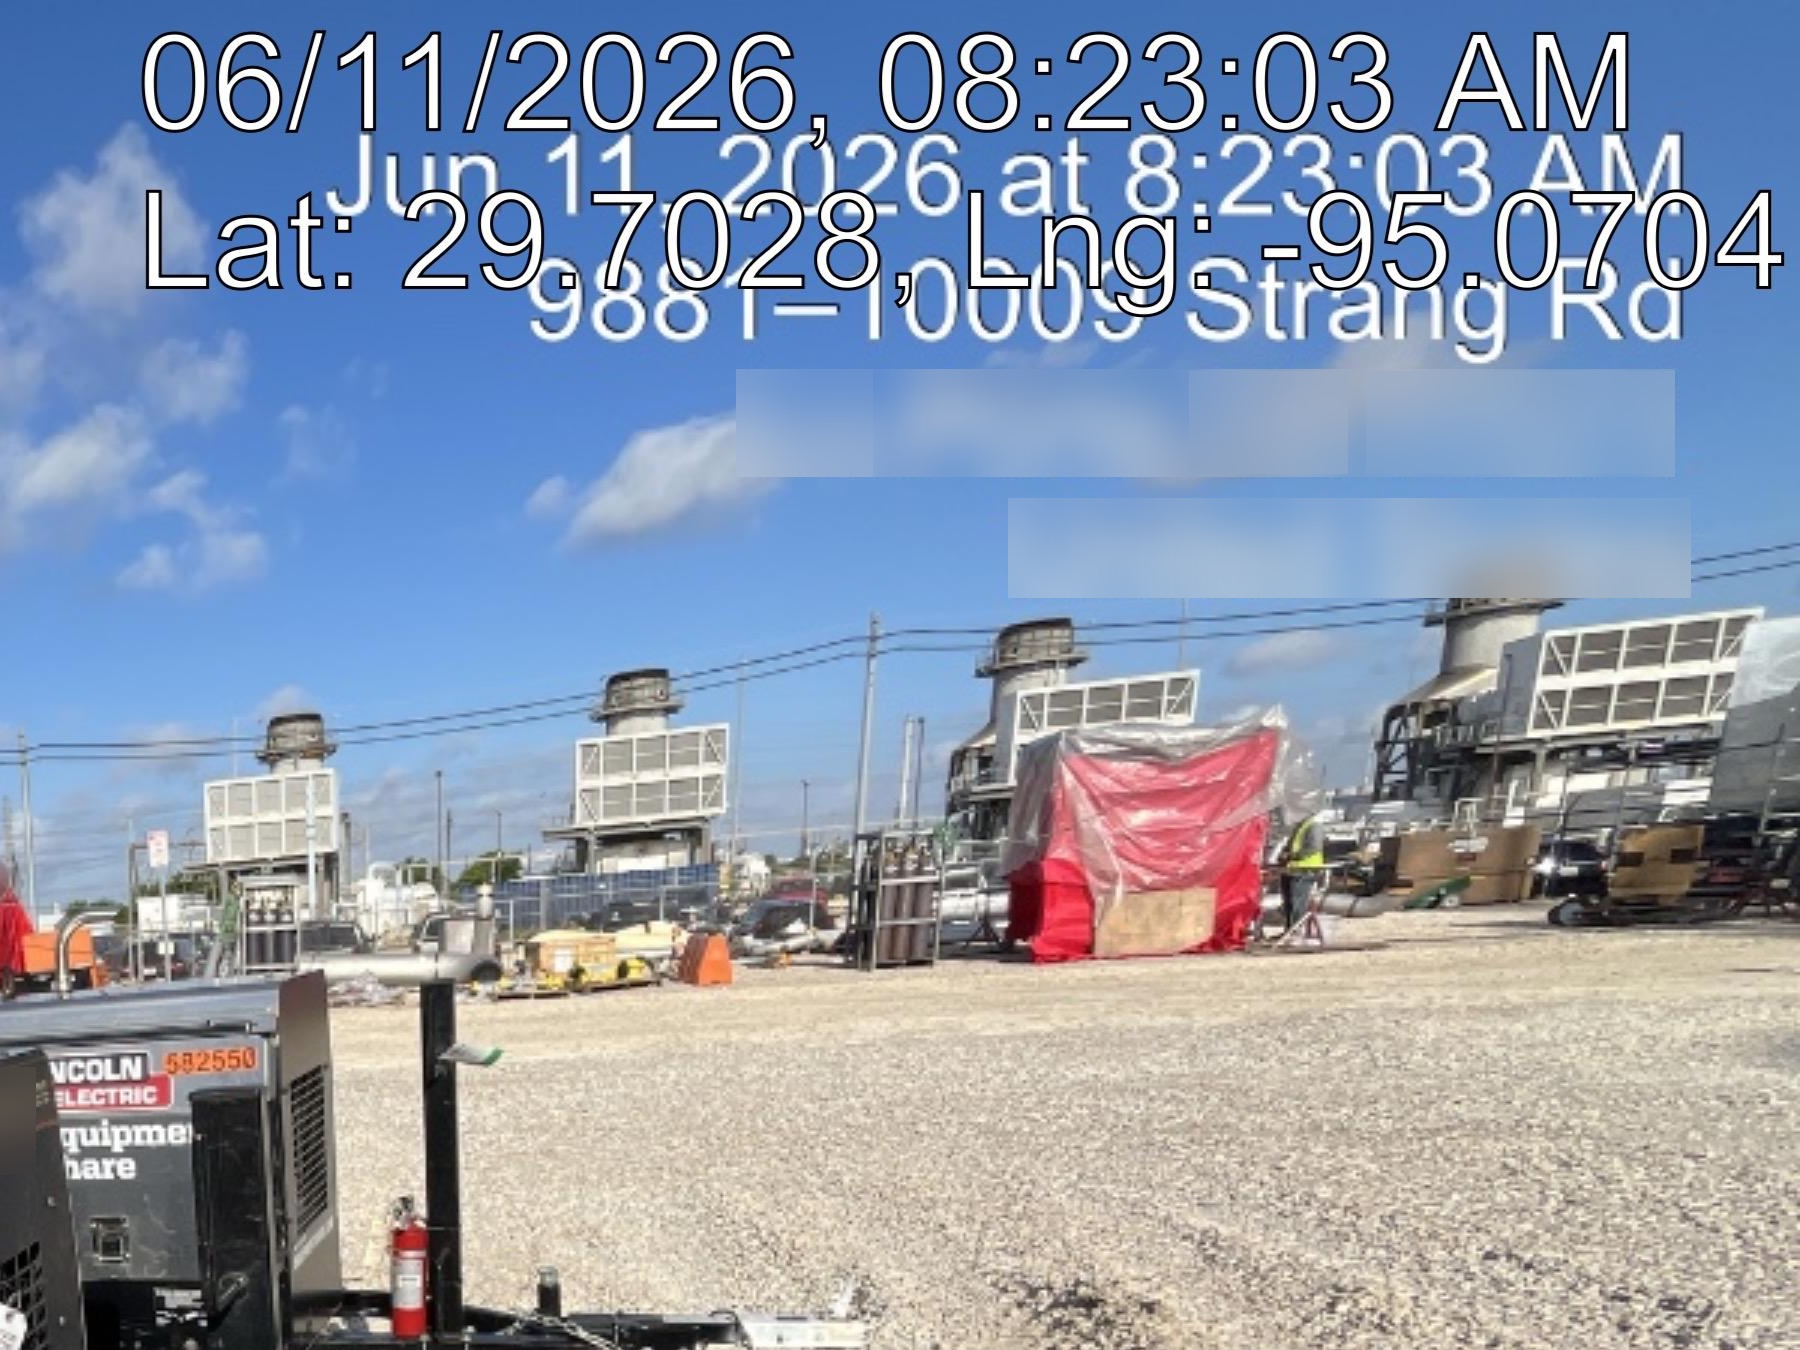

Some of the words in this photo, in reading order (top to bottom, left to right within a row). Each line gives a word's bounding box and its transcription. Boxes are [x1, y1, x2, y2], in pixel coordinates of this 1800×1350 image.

[49, 1055, 143, 1084] NCOLN
[60, 1118, 194, 1153] quipme
[63, 1154, 137, 1180] hare
